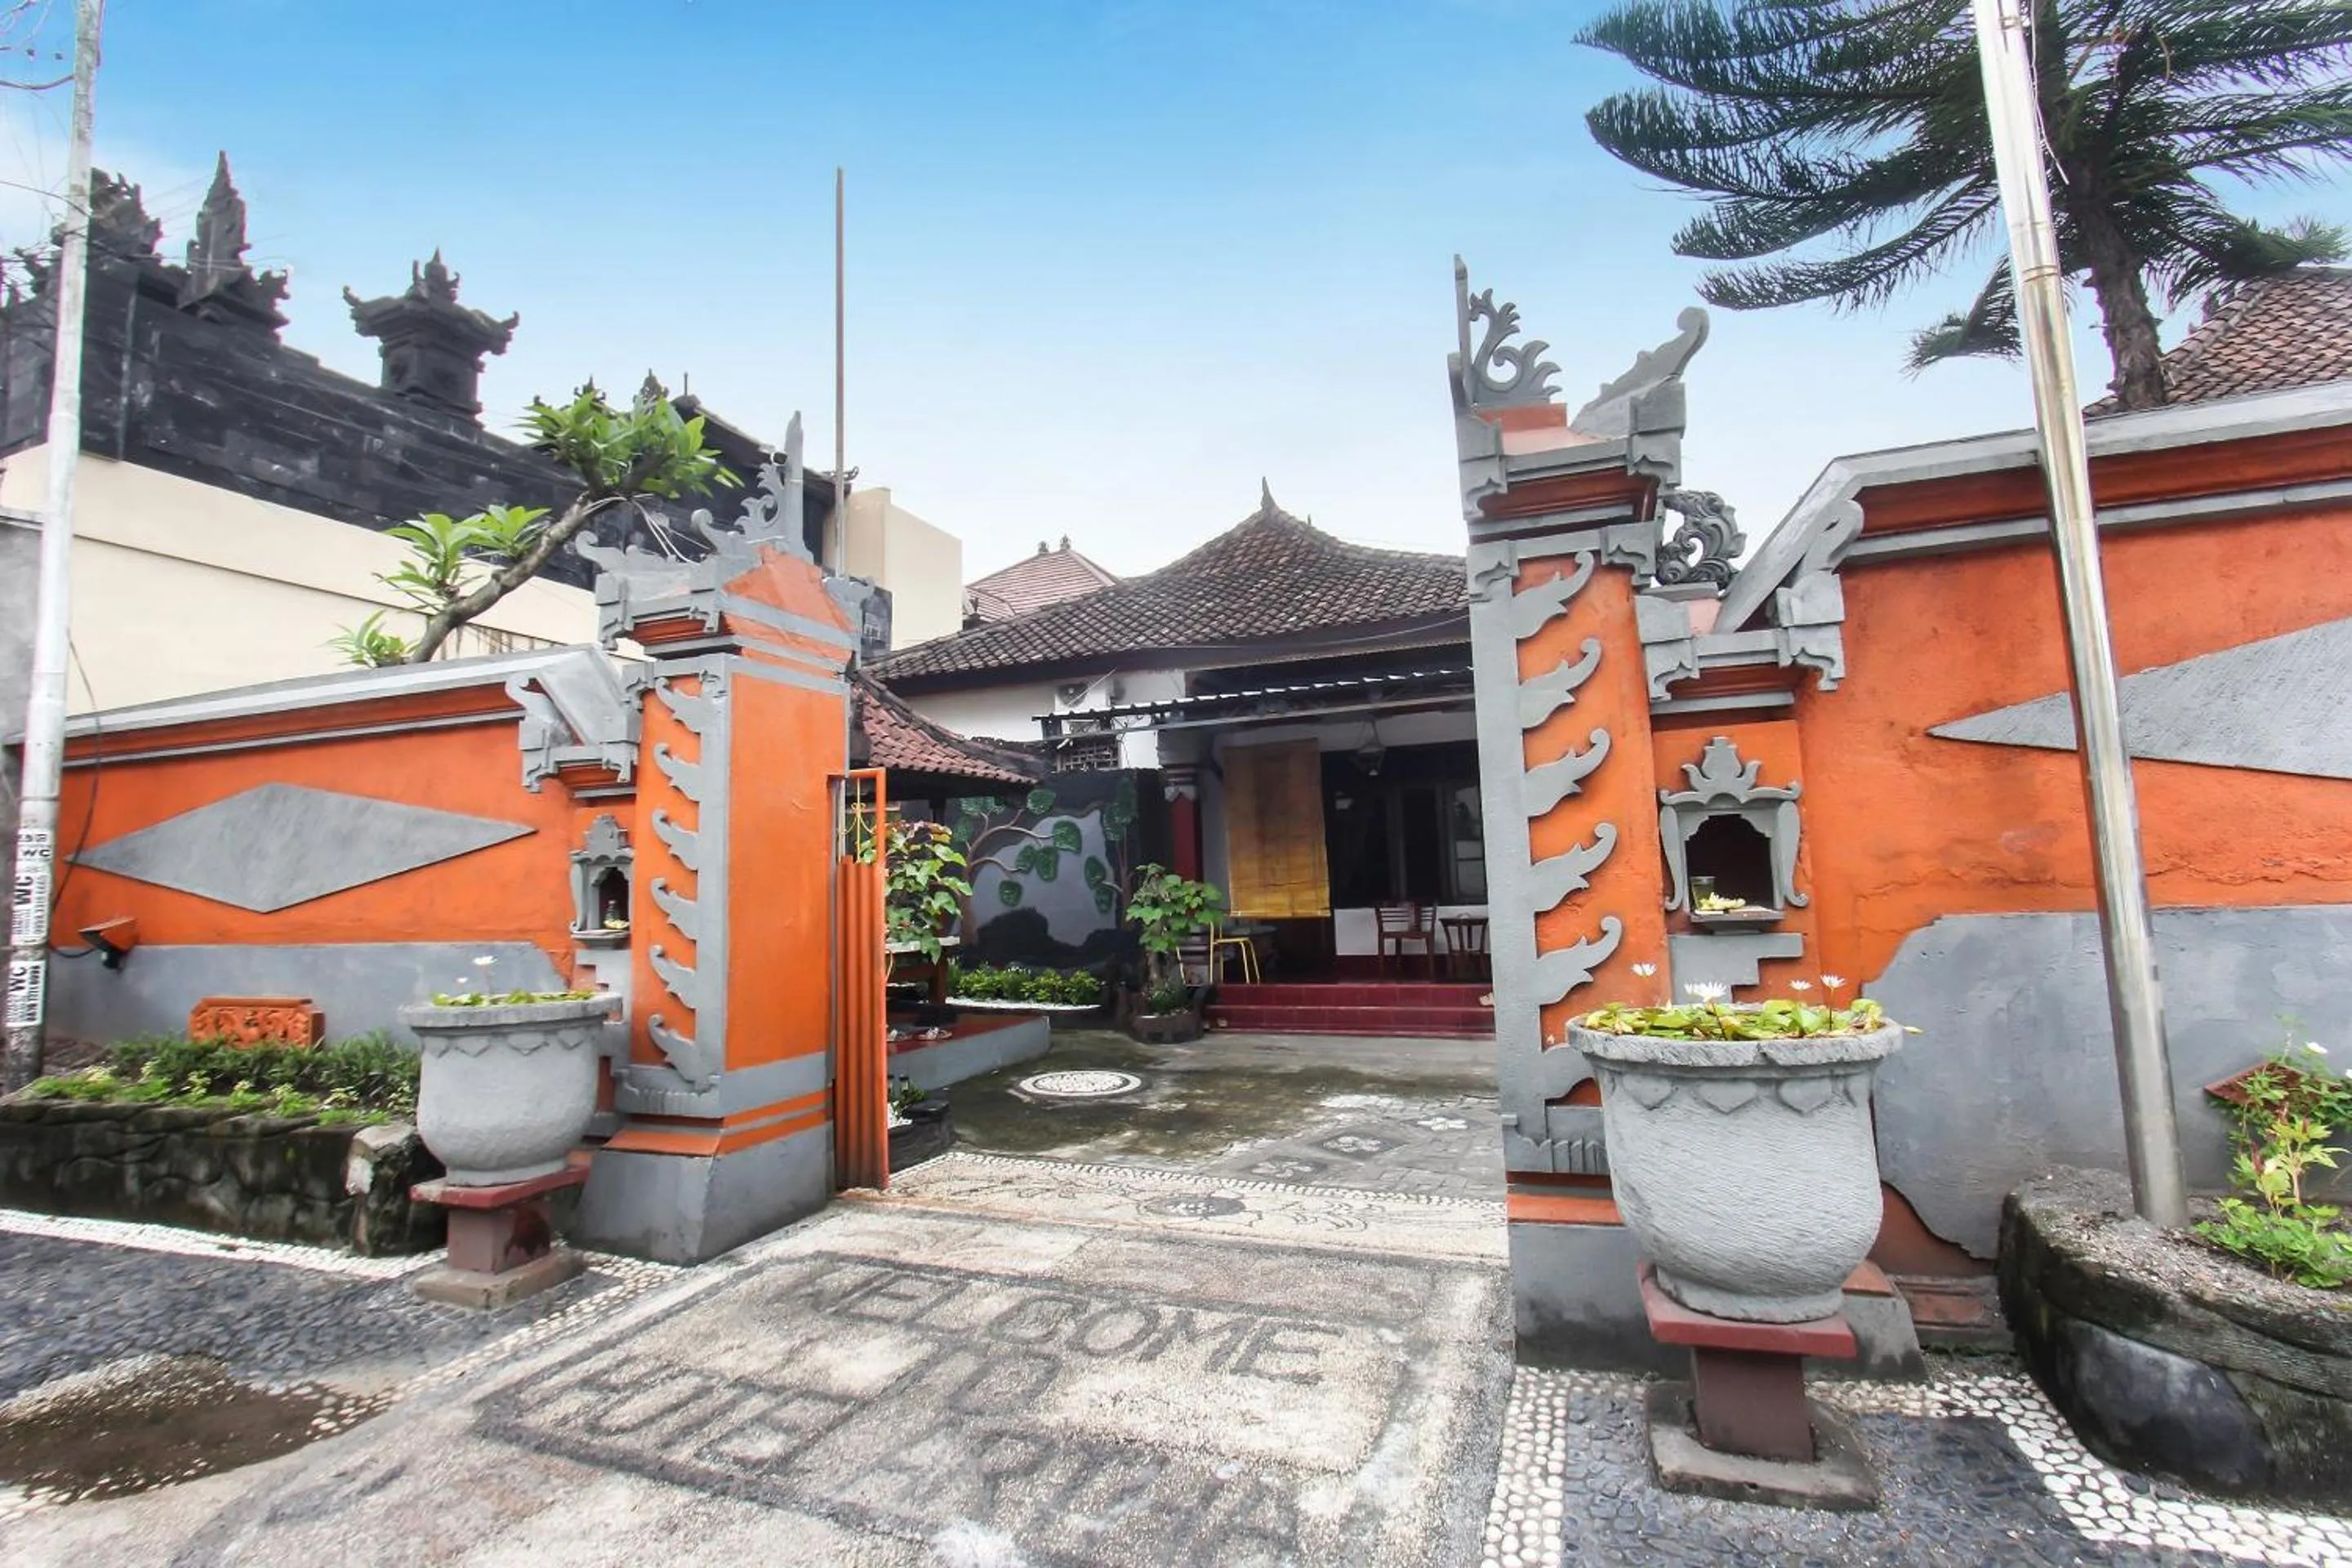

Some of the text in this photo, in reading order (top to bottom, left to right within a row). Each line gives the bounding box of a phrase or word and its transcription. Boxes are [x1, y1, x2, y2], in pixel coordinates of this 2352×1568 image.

[12, 876, 33, 906] WC
[8, 967, 26, 991] WC
[751, 1263, 1349, 1387] WELCOME
[505, 1356, 886, 1480] HOTEL
